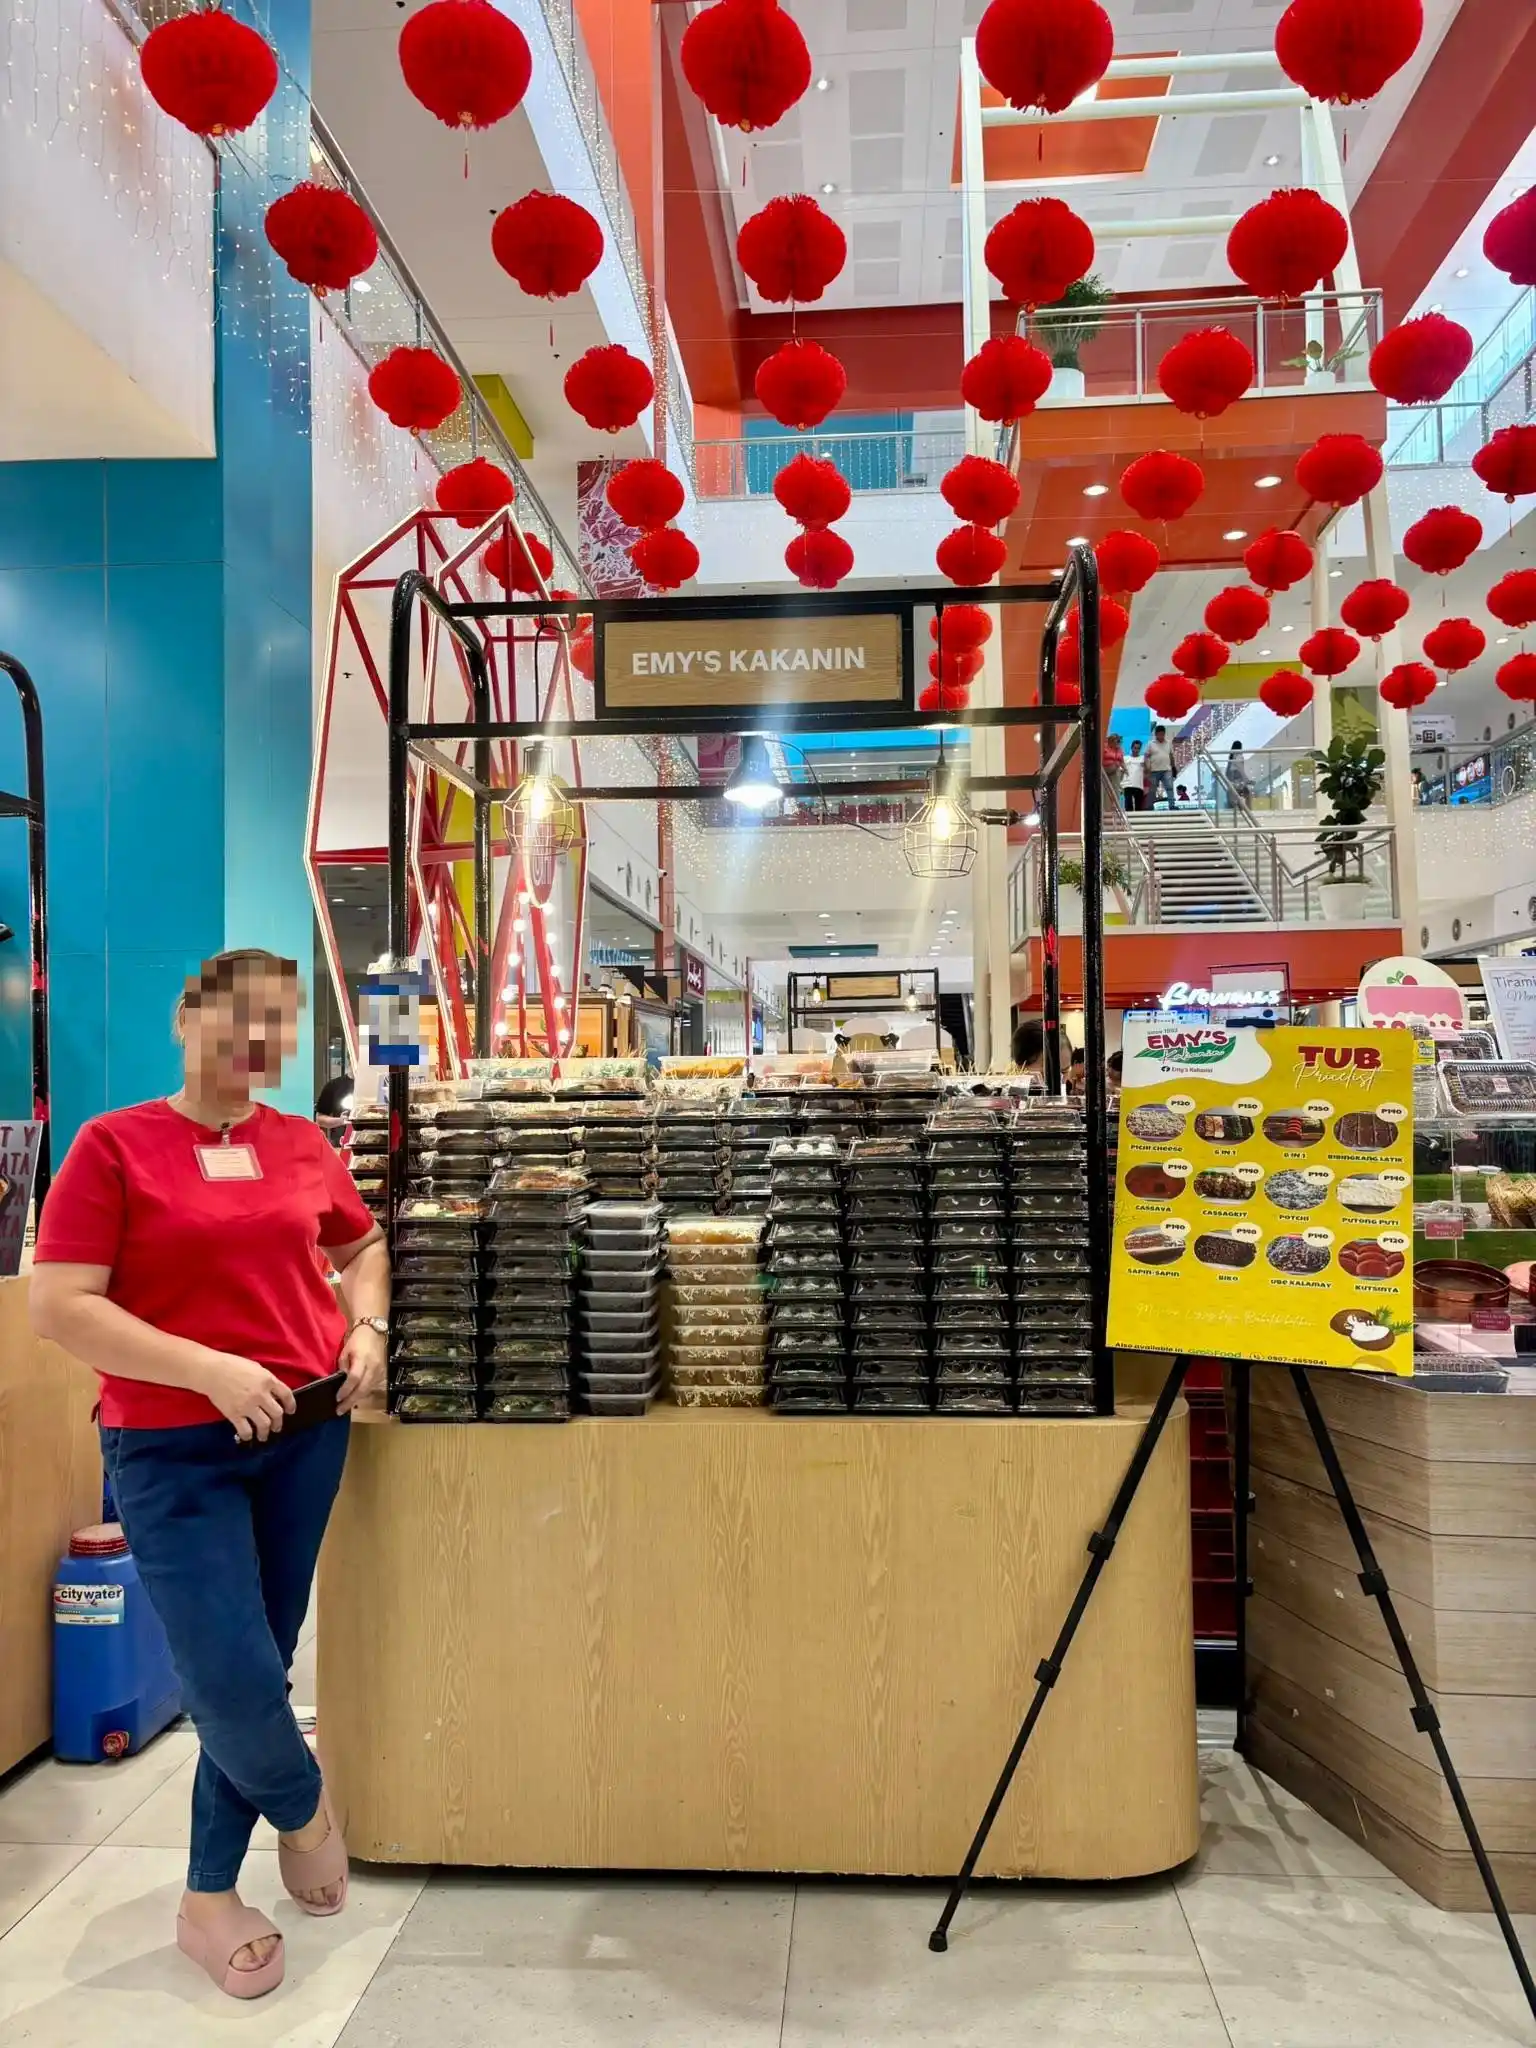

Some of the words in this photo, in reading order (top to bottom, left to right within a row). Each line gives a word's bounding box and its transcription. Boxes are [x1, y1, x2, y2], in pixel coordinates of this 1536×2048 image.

[632, 650, 722, 676] EMY'S
[729, 646, 865, 673] KAKANIN
[1147, 1029, 1229, 1050] EMY'S
[1298, 1045, 1382, 1070] TUB
